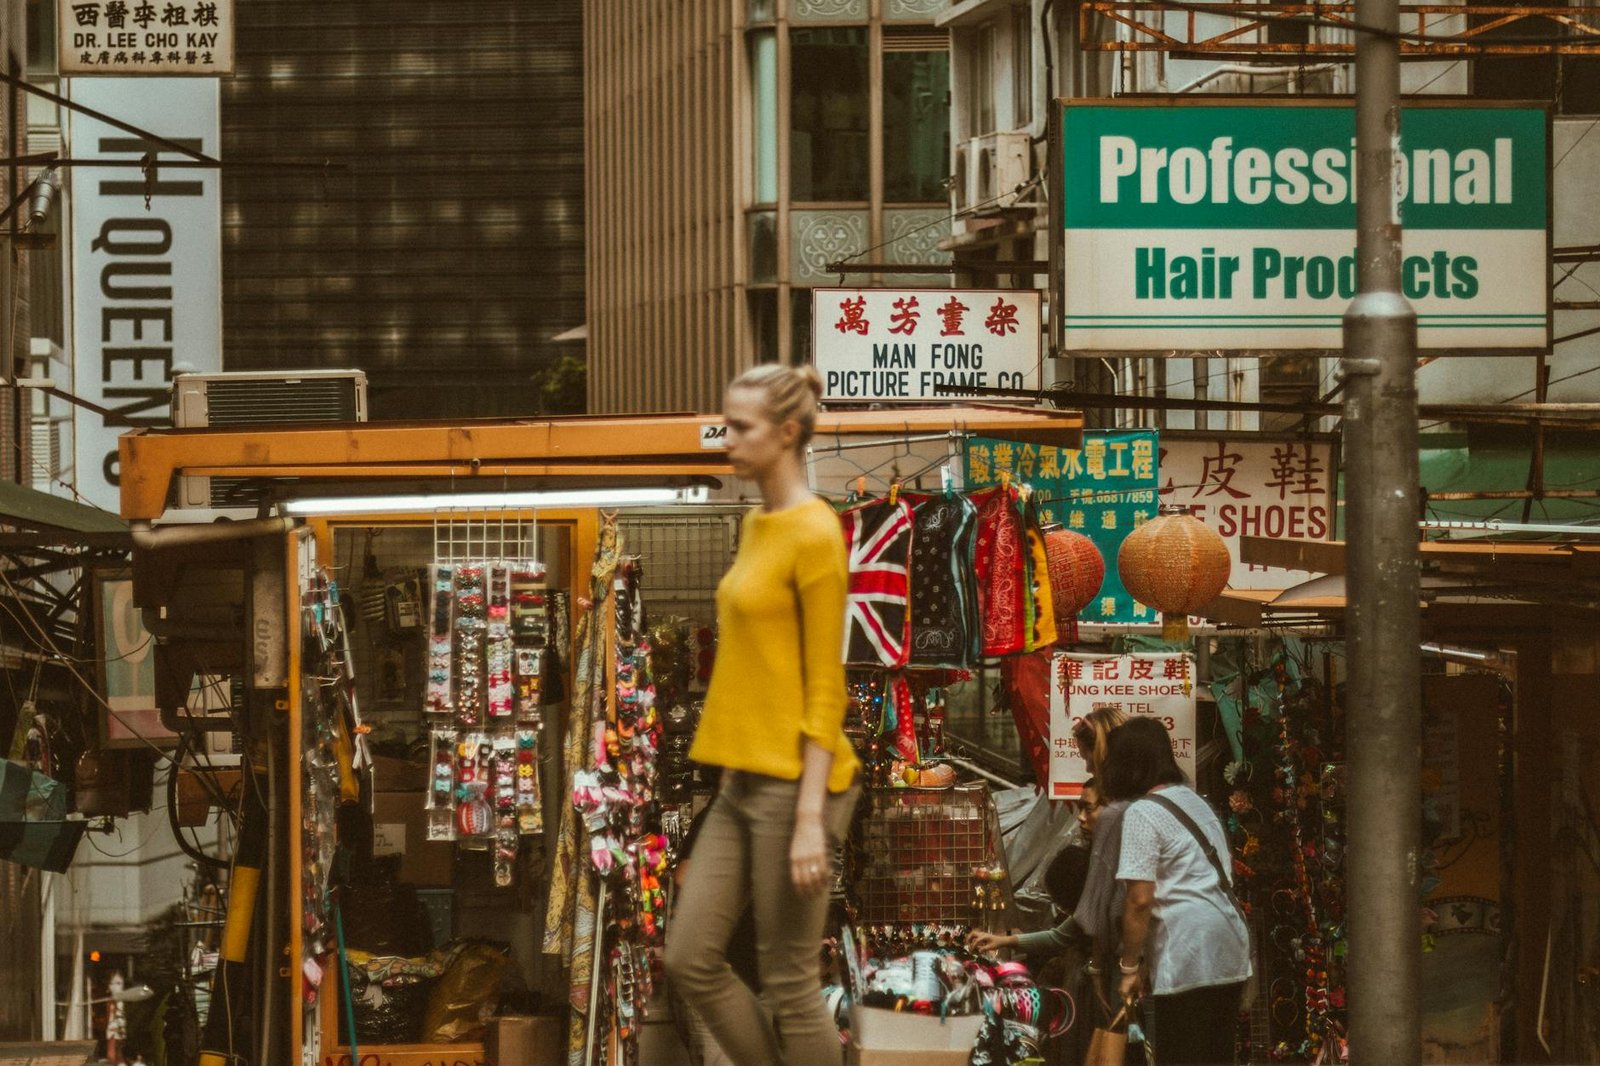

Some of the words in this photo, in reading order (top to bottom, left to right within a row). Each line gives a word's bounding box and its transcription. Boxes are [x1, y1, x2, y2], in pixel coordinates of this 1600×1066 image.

[74, 33, 101, 48] DR.
[107, 33, 137, 48] LEE
[145, 33, 178, 48] CHO
[187, 33, 218, 48] KAY
[98, 138, 203, 196] H
[1100, 135, 1513, 204] Professnal
[1135, 247, 1239, 300] Hair
[1253, 247, 1479, 300] Prodcts
[834, 295, 1020, 337] 萬芳畫架
[873, 344, 916, 369] MAN
[931, 344, 983, 370] FONG
[827, 371, 909, 396] PICTURE
[920, 371, 987, 396] FRAME
[1218, 504, 1327, 539] SHOES
[1057, 685, 1099, 695] YUNG
[1104, 685, 1134, 695] KEE
[1127, 703, 1154, 714] TEL
